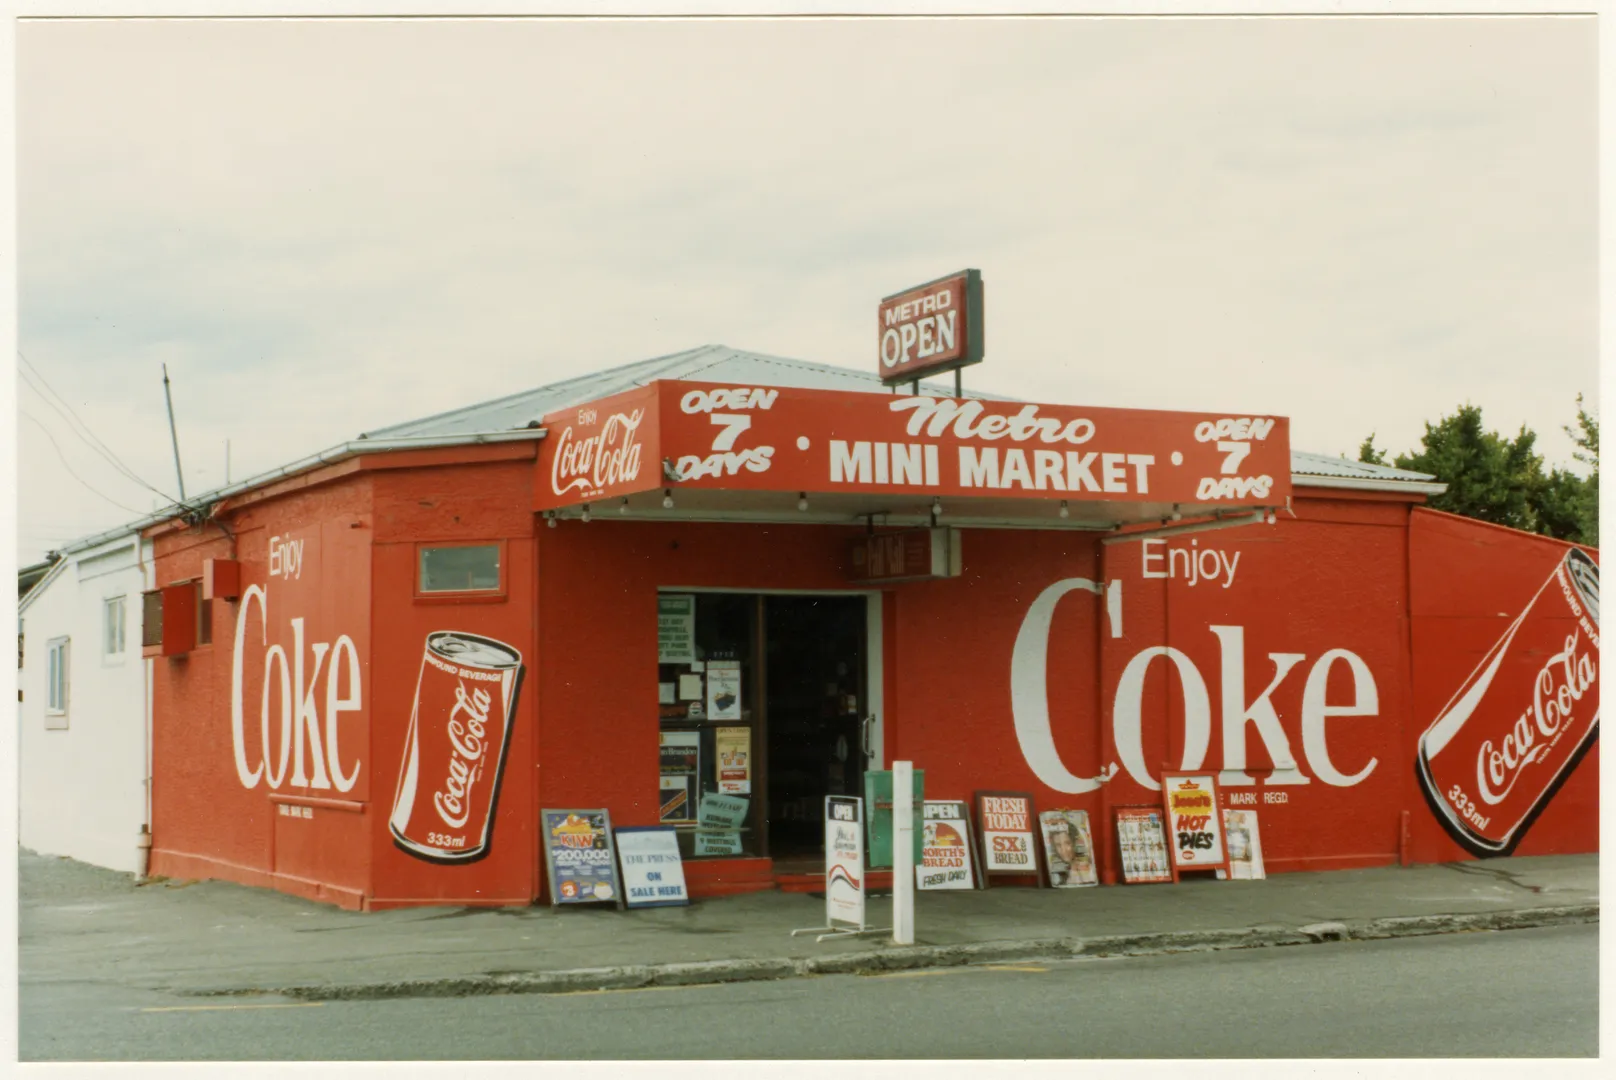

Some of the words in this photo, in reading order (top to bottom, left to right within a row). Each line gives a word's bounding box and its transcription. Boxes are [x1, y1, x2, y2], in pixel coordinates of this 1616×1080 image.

[885, 289, 952, 326] METRO
[881, 309, 957, 368] OPEN
[680, 388, 779, 414] OPEN
[578, 409, 597, 426] Enjoy
[889, 397, 1096, 444] Metro
[710, 413, 751, 451] 7
[1194, 418, 1275, 443] OPEN
[676, 446, 775, 482] DAYS
[829, 440, 940, 486] MINI
[958, 446, 1155, 494] MARKET
[1217, 440, 1251, 474] 7
[1195, 474, 1274, 500] DAYS
[269, 532, 304, 580] Enjoy
[1142, 538, 1240, 589] Enjoy
[231, 583, 362, 793] Coke
[1011, 577, 1379, 794] Coke
[984, 797, 1026, 813] FRESH
[1230, 792, 1257, 805] MARK
[1263, 791, 1288, 804] REGD
[1448, 785, 1491, 831] 333ml
[923, 804, 961, 818] PEN
[984, 813, 1027, 830] TODAY
[1176, 814, 1211, 831] HOT
[427, 831, 466, 847] 333ml
[1178, 832, 1214, 850] PIES
[923, 858, 963, 867] BREAD
[994, 852, 1028, 864] BREAD
[646, 872, 662, 881] ON
[923, 873, 946, 888] FRESH
[630, 887, 655, 897] SALE
[658, 886, 683, 897] HERE
